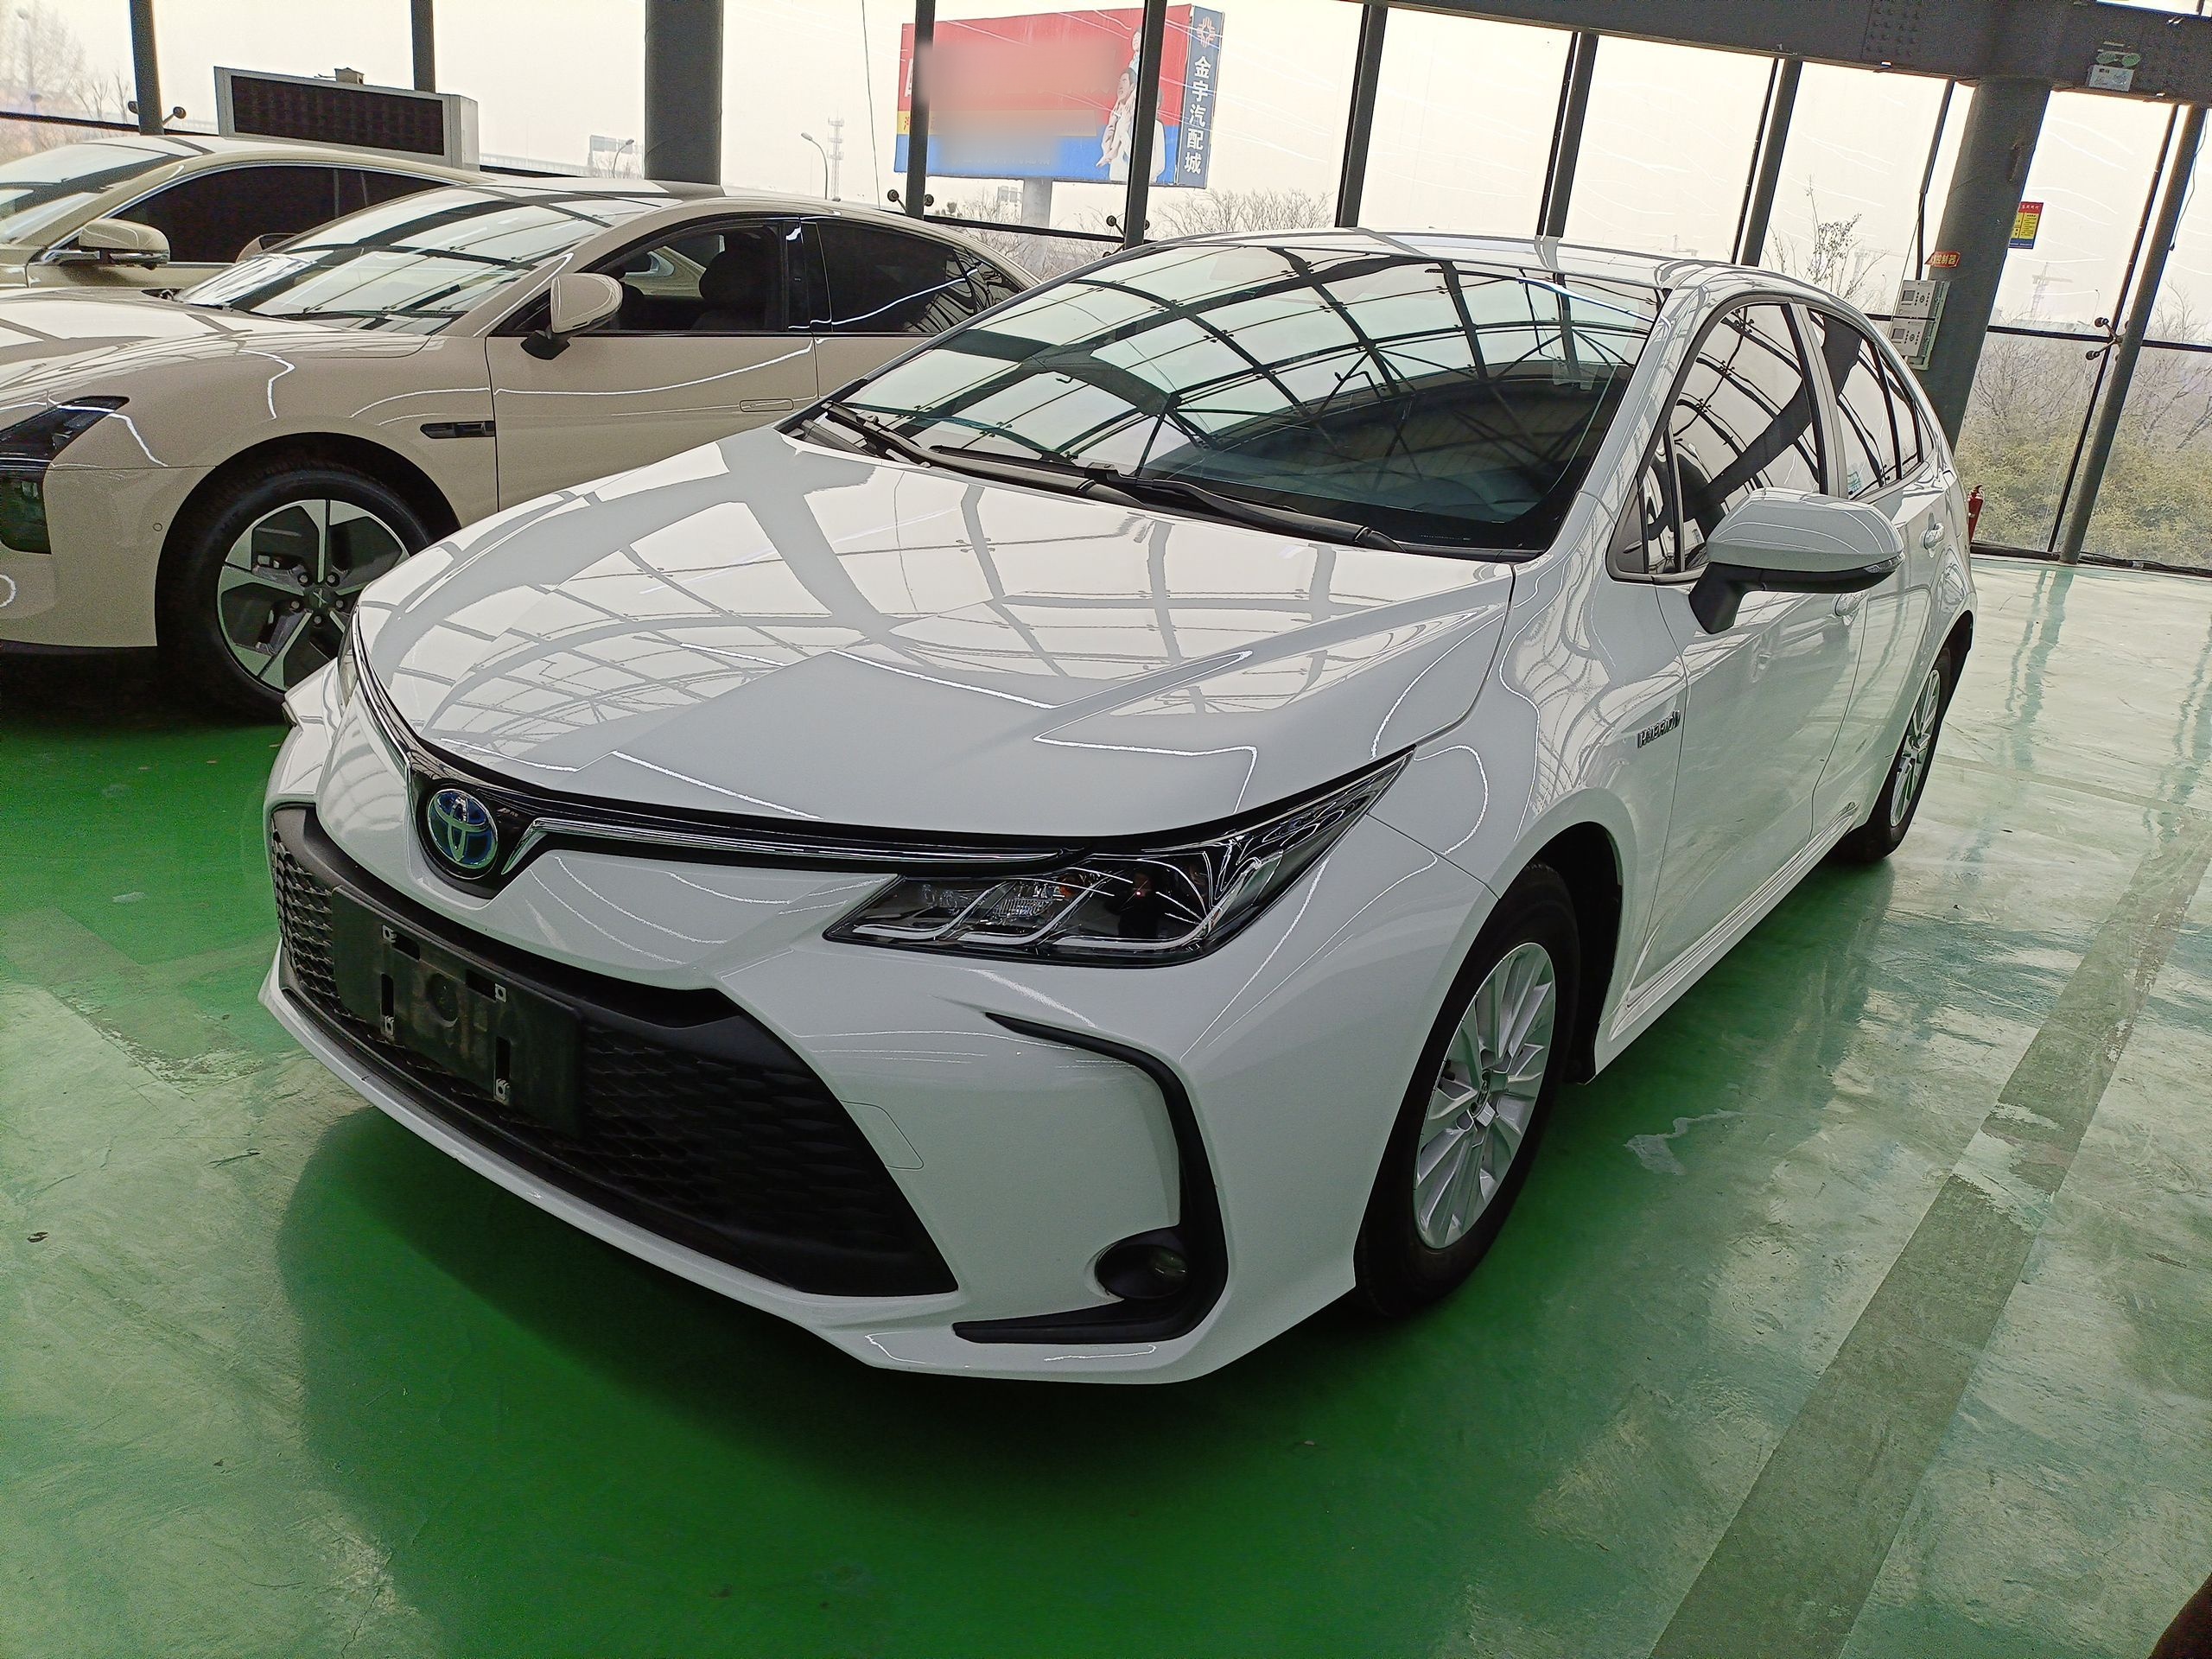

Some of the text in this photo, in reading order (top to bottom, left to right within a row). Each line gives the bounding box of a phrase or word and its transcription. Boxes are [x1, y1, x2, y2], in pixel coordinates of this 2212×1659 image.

[1185, 56, 1211, 174] 金宇汽配城
[1637, 714, 1675, 748] HYBRID
